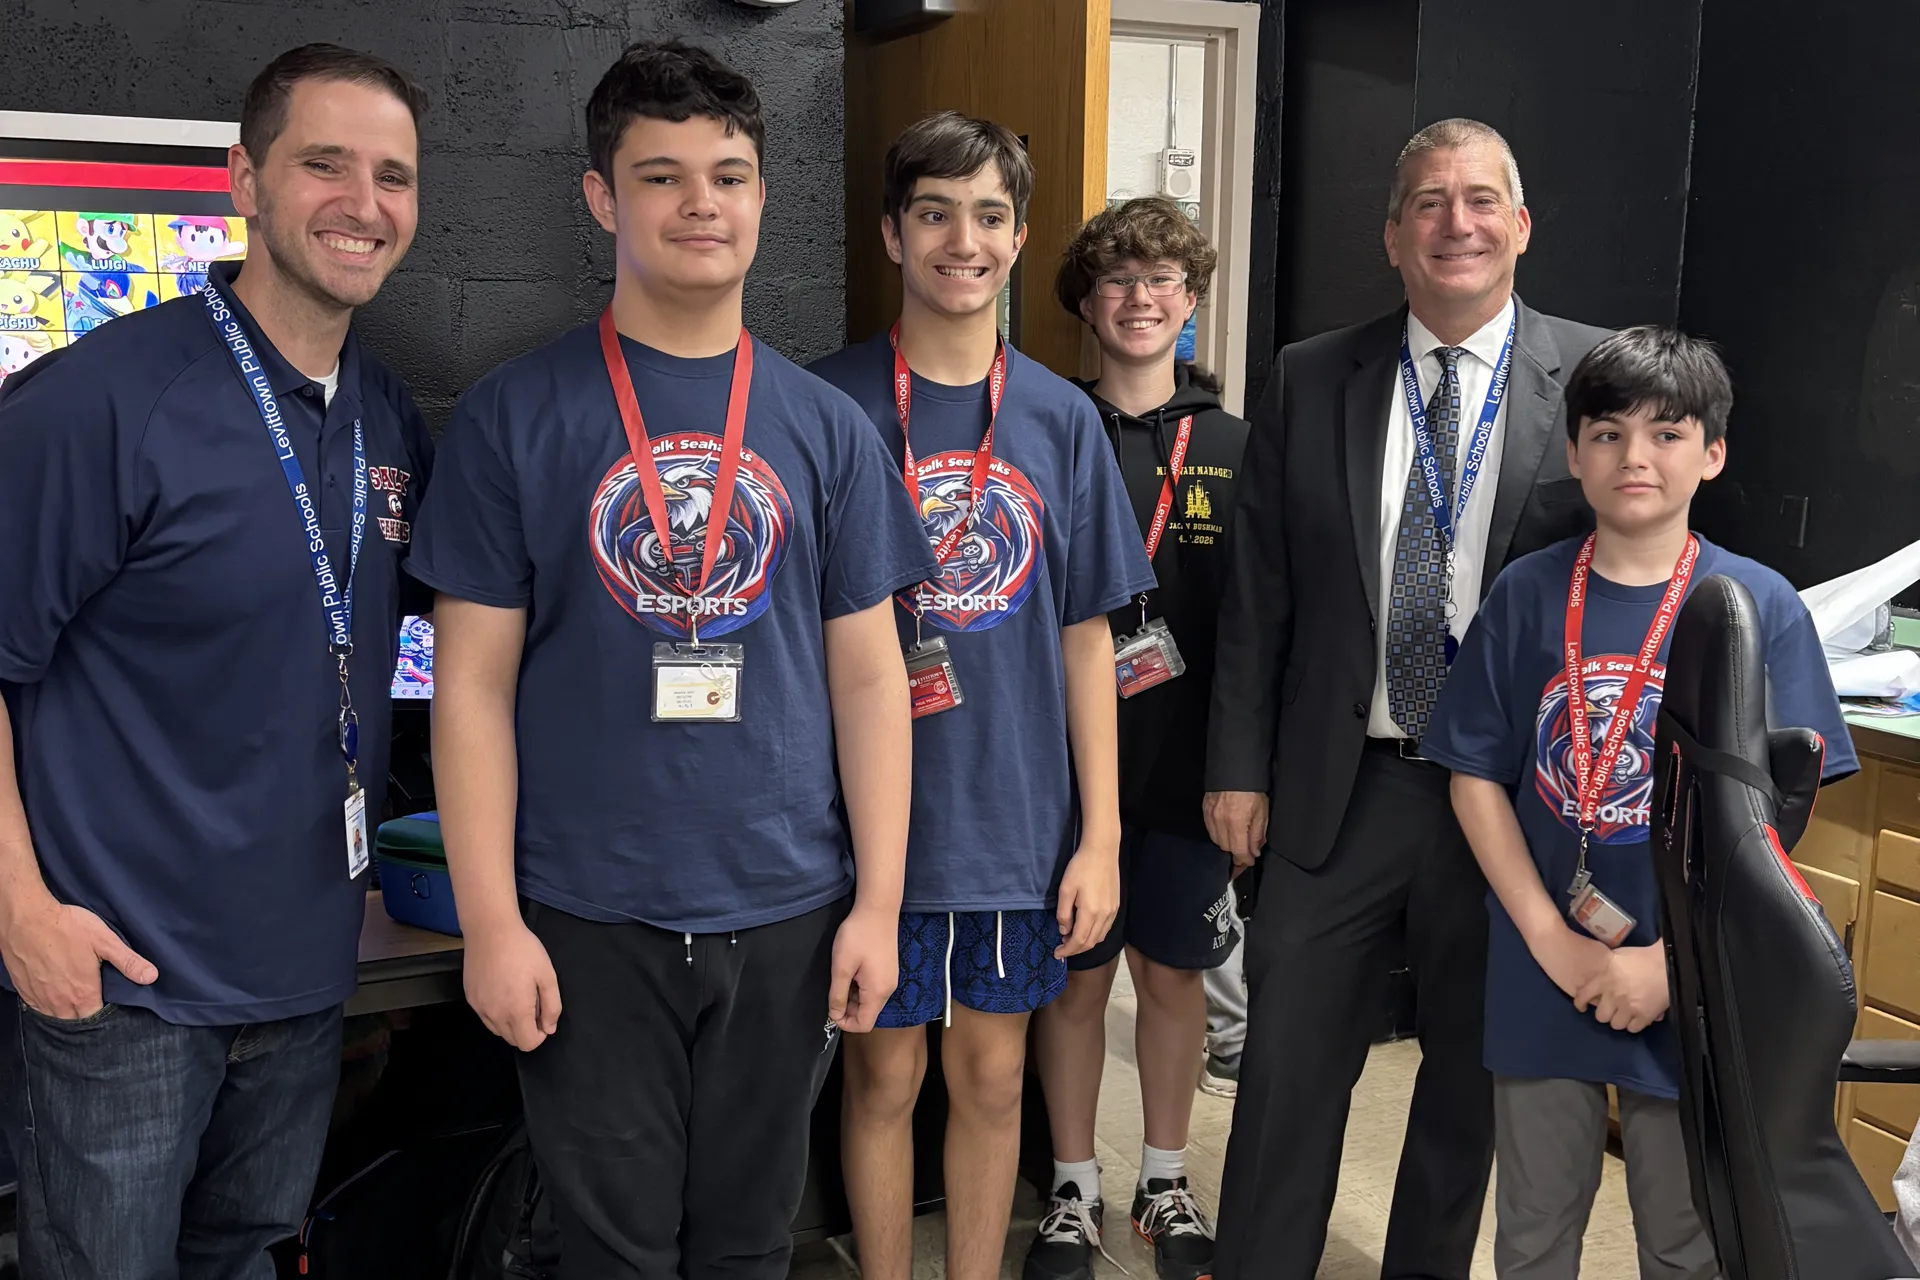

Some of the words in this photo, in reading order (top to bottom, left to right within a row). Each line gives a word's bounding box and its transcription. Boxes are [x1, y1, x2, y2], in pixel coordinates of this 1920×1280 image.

[91, 259, 127, 271] LUIGI
[202, 280, 230, 322] Schoo
[225, 322, 260, 373] Public
[897, 373, 908, 420] Schools
[1487, 348, 1513, 404] Levittown
[253, 375, 294, 460] Levittown
[1402, 358, 1421, 415] Levittown
[1413, 415, 1431, 456] Public
[1422, 456, 1443, 508] Schools
[652, 439, 675, 455] alk
[917, 456, 944, 476] Salk
[1457, 474, 1475, 517] Public
[1466, 420, 1492, 472] Schools
[354, 456, 367, 508] Public
[296, 482, 324, 553] Schools
[316, 554, 341, 608] Public
[1146, 502, 1169, 553] Levittown
[636, 593, 748, 616] ESPORTS
[921, 594, 1009, 612] ESPORTS
[1570, 565, 1586, 608] Schools
[1635, 614, 1670, 674] Levittown
[1661, 577, 1685, 613] Public
[1567, 642, 1581, 705] Levittown
[1573, 708, 1588, 749] Public
[1589, 759, 1612, 799] Public
[1603, 708, 1630, 758] Schools
